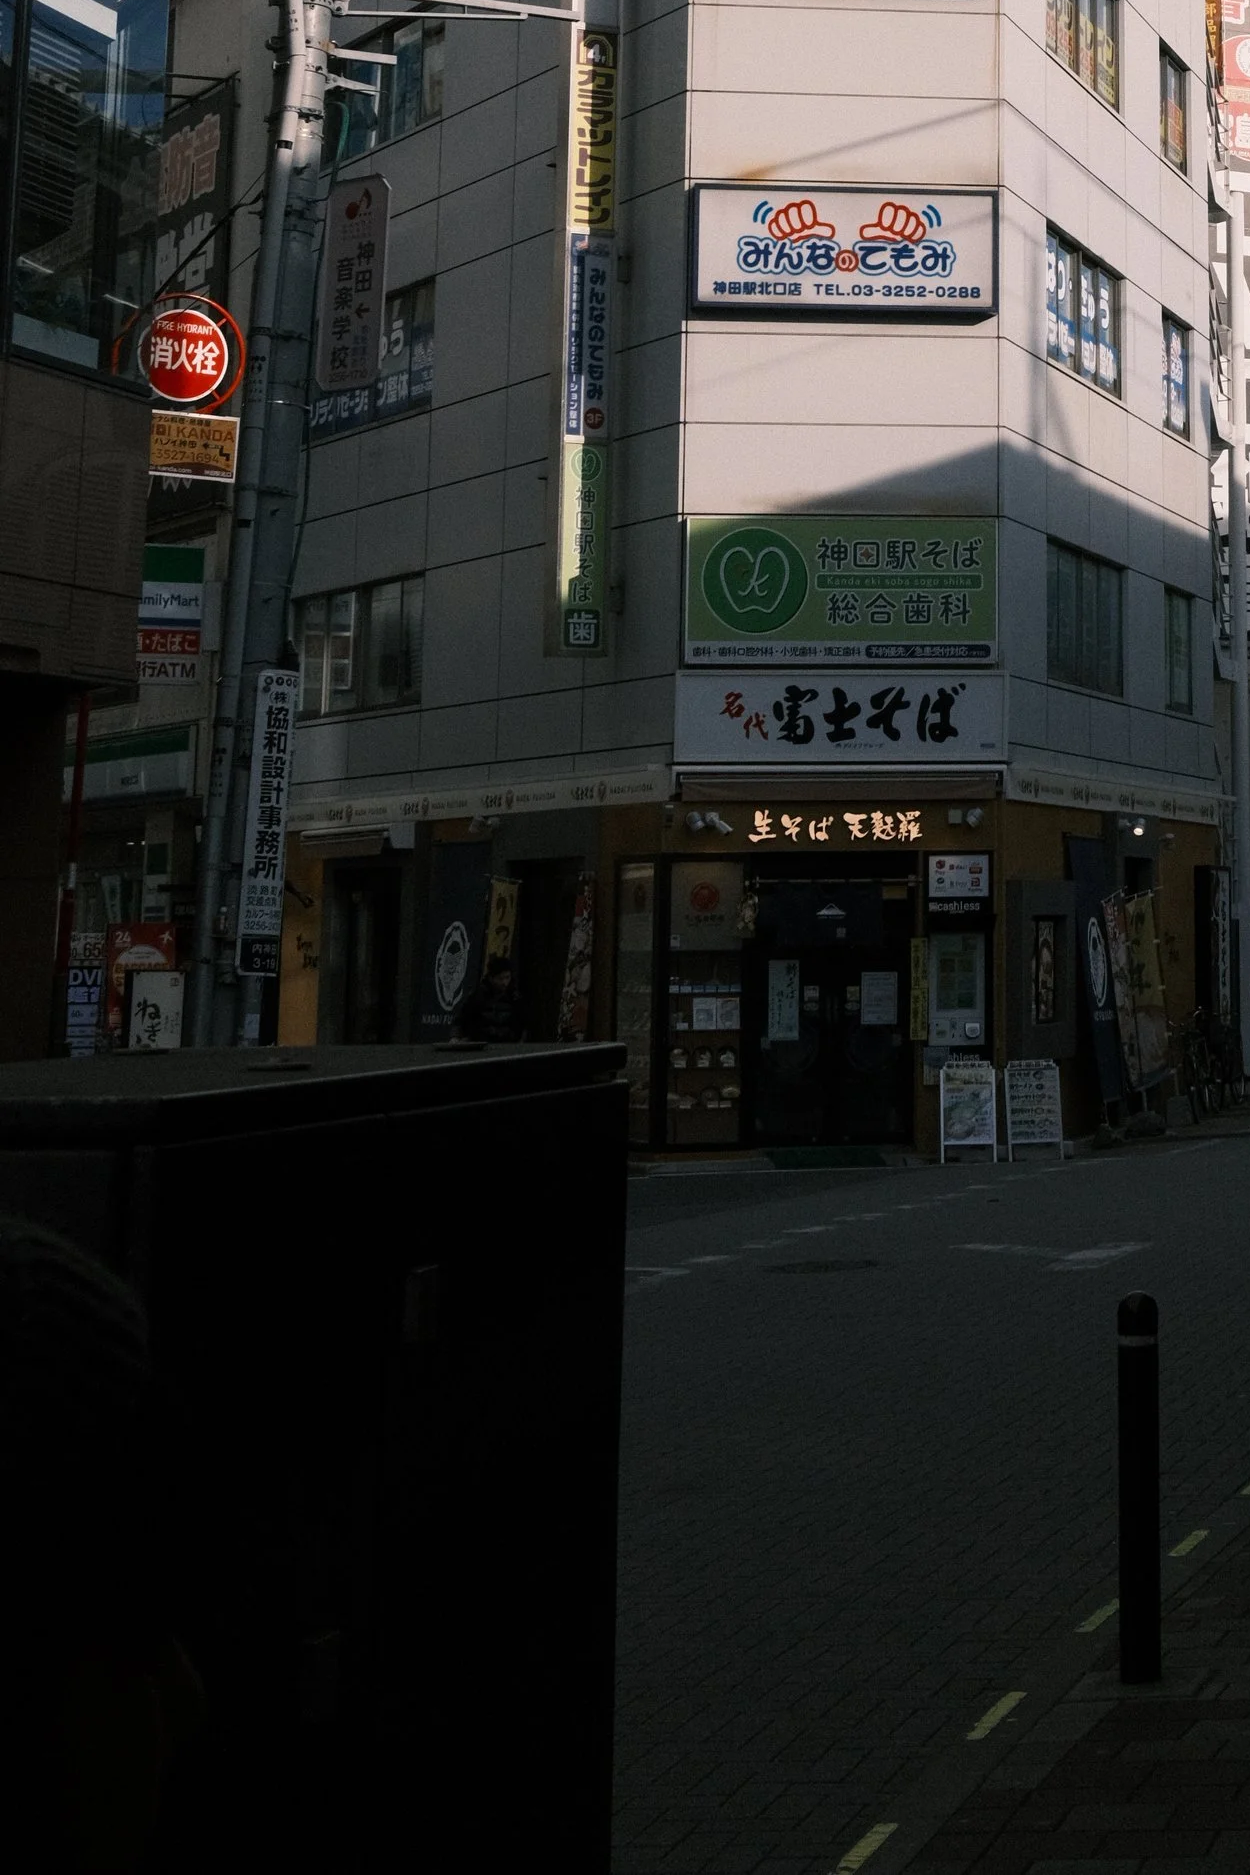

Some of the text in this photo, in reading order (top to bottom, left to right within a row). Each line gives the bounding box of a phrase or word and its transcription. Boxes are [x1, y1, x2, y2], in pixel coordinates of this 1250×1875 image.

[574, 68, 615, 226] カラマツトレイン
[354, 240, 376, 294] 神田
[739, 237, 954, 276] みんなのてもみ
[712, 281, 802, 296] 神田駅北口店
[156, 320, 214, 336] FIRE HYDRANT
[330, 256, 355, 371] 音楽学校
[150, 335, 221, 376] 消火栓
[175, 426, 235, 443] KANDA
[587, 412, 603, 425] 3F
[827, 591, 973, 626] 総合歯科
[567, 611, 598, 646] 歯
[718, 681, 967, 746] 名代 富士そば
[254, 704, 290, 881] 協和設計事務所
[747, 809, 834, 843] 生そば
[115, 931, 132, 944] 24
